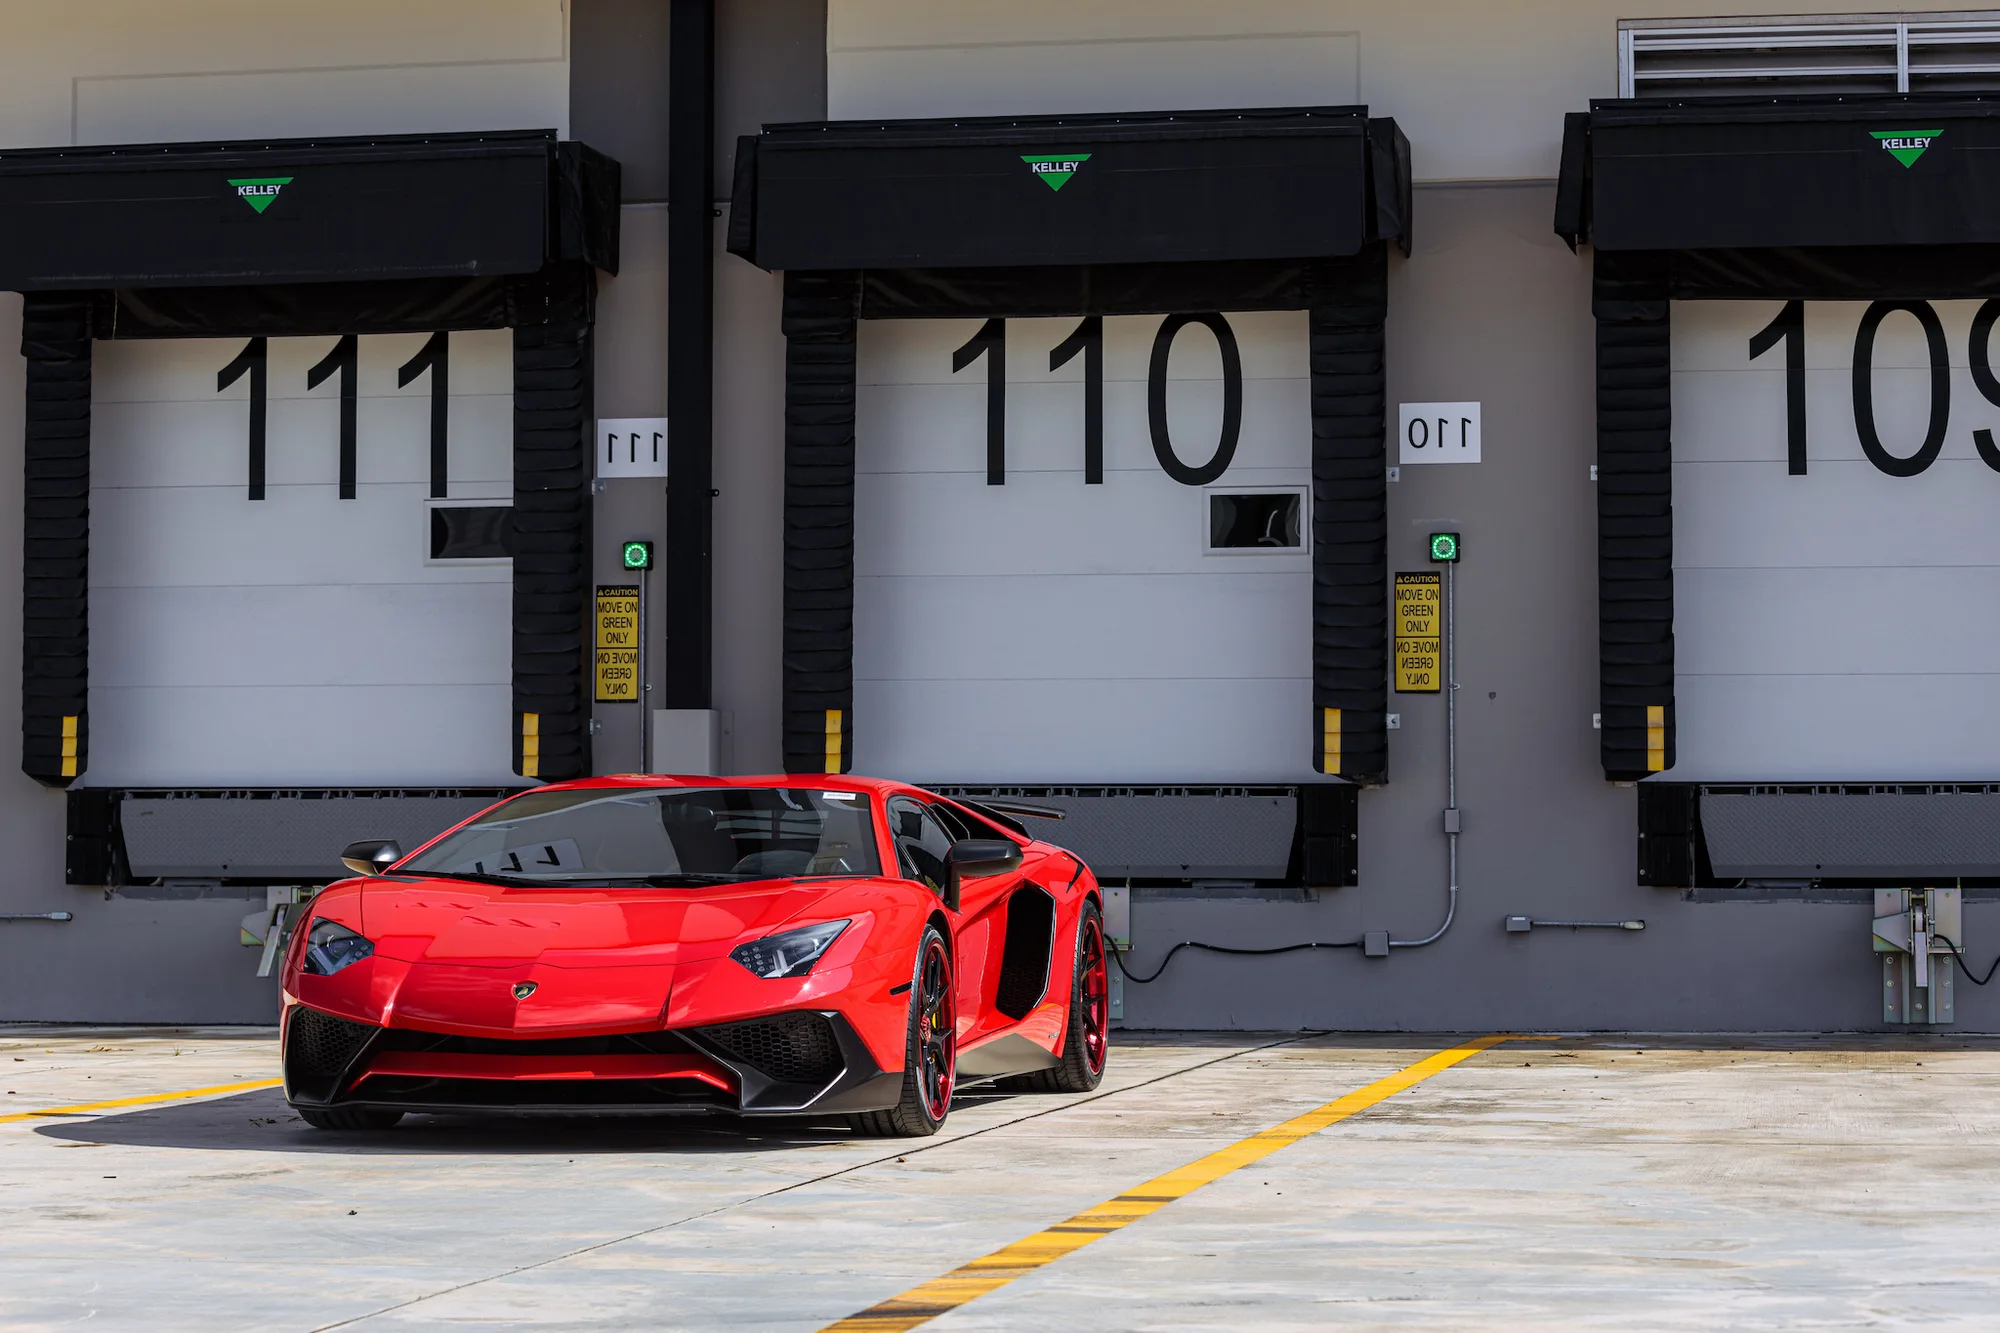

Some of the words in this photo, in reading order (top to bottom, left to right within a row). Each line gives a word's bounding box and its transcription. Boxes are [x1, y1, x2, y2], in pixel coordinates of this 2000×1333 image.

[1882, 137, 1931, 149] KELLEY
[1032, 161, 1079, 173] KELLEY
[238, 185, 281, 196] KELLEY
[952, 312, 1243, 486] 110
[217, 331, 449, 500] 111
[1403, 575, 1439, 583] CAUTION
[604, 588, 639, 596] CAUTION
[1396, 588, 1423, 601] MOVE
[1425, 588, 1439, 601] ON
[598, 601, 623, 613] MOVE
[624, 601, 638, 613] ON
[1401, 604, 1434, 617] GREEN
[602, 616, 633, 629] GREEN
[1405, 620, 1430, 633] ONLY
[605, 631, 629, 644] ONLY
